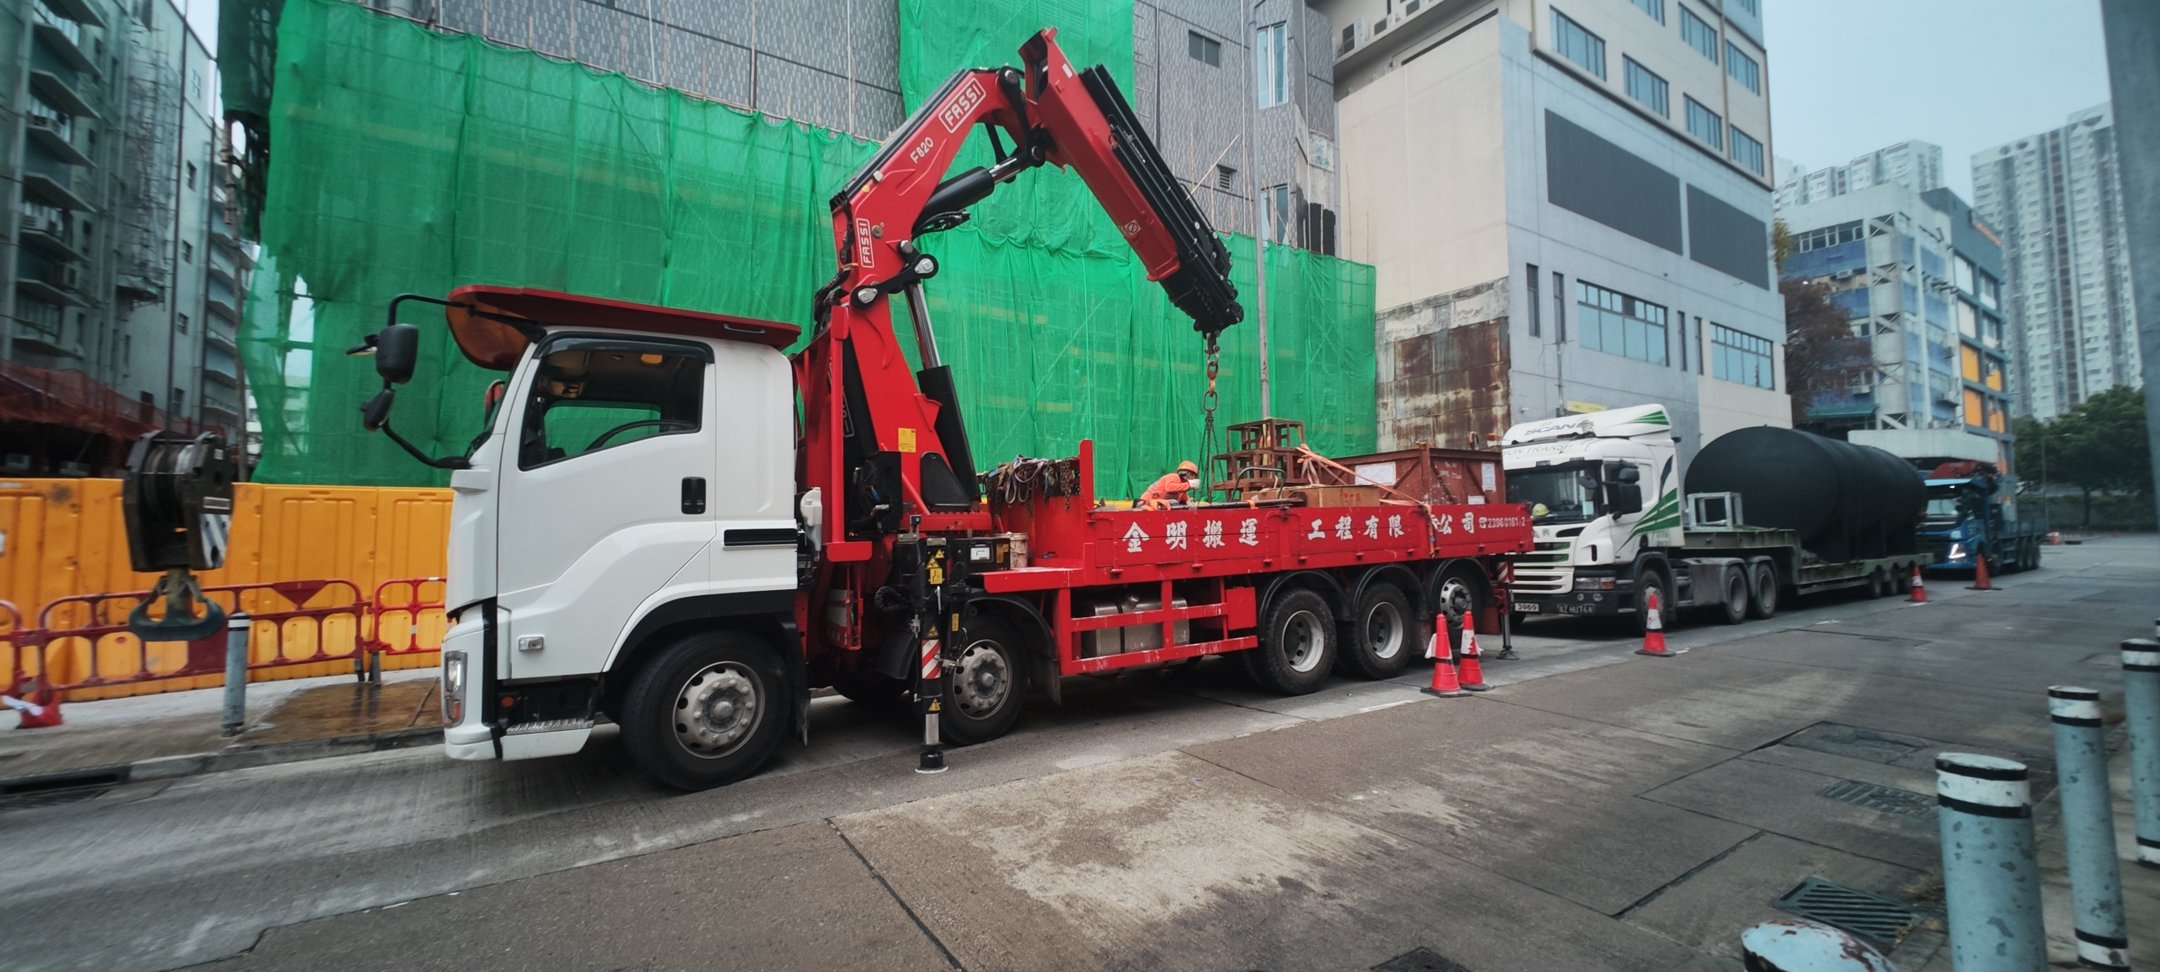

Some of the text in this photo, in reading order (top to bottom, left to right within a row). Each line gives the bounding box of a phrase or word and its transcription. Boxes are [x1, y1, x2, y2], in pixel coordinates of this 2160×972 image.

[944, 83, 982, 127] FASSI
[910, 136, 934, 165] F820
[859, 222, 872, 264] FASSI
